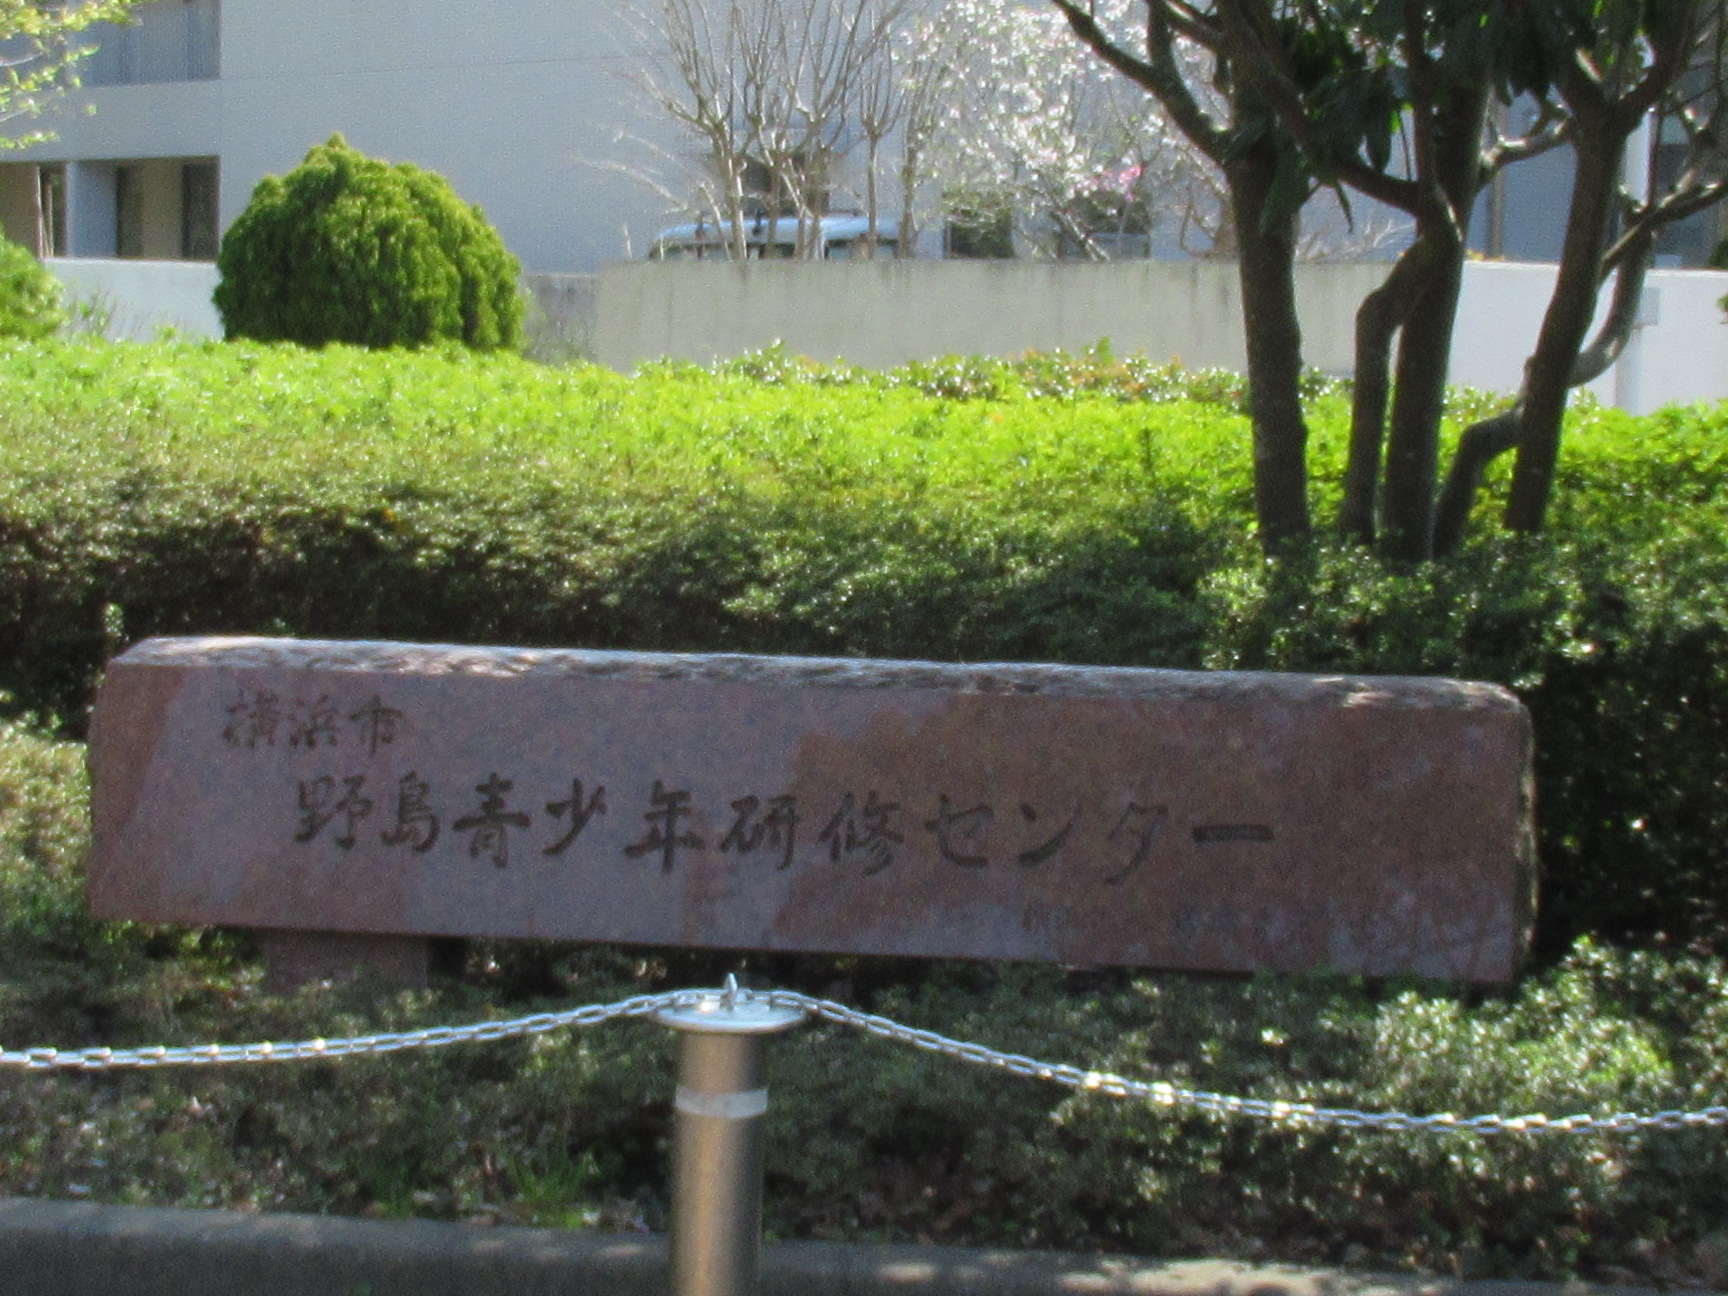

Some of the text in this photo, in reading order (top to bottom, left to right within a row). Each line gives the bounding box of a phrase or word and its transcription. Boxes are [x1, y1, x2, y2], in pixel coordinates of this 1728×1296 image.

[294, 770, 1272, 886] 野島青少年研修センター
